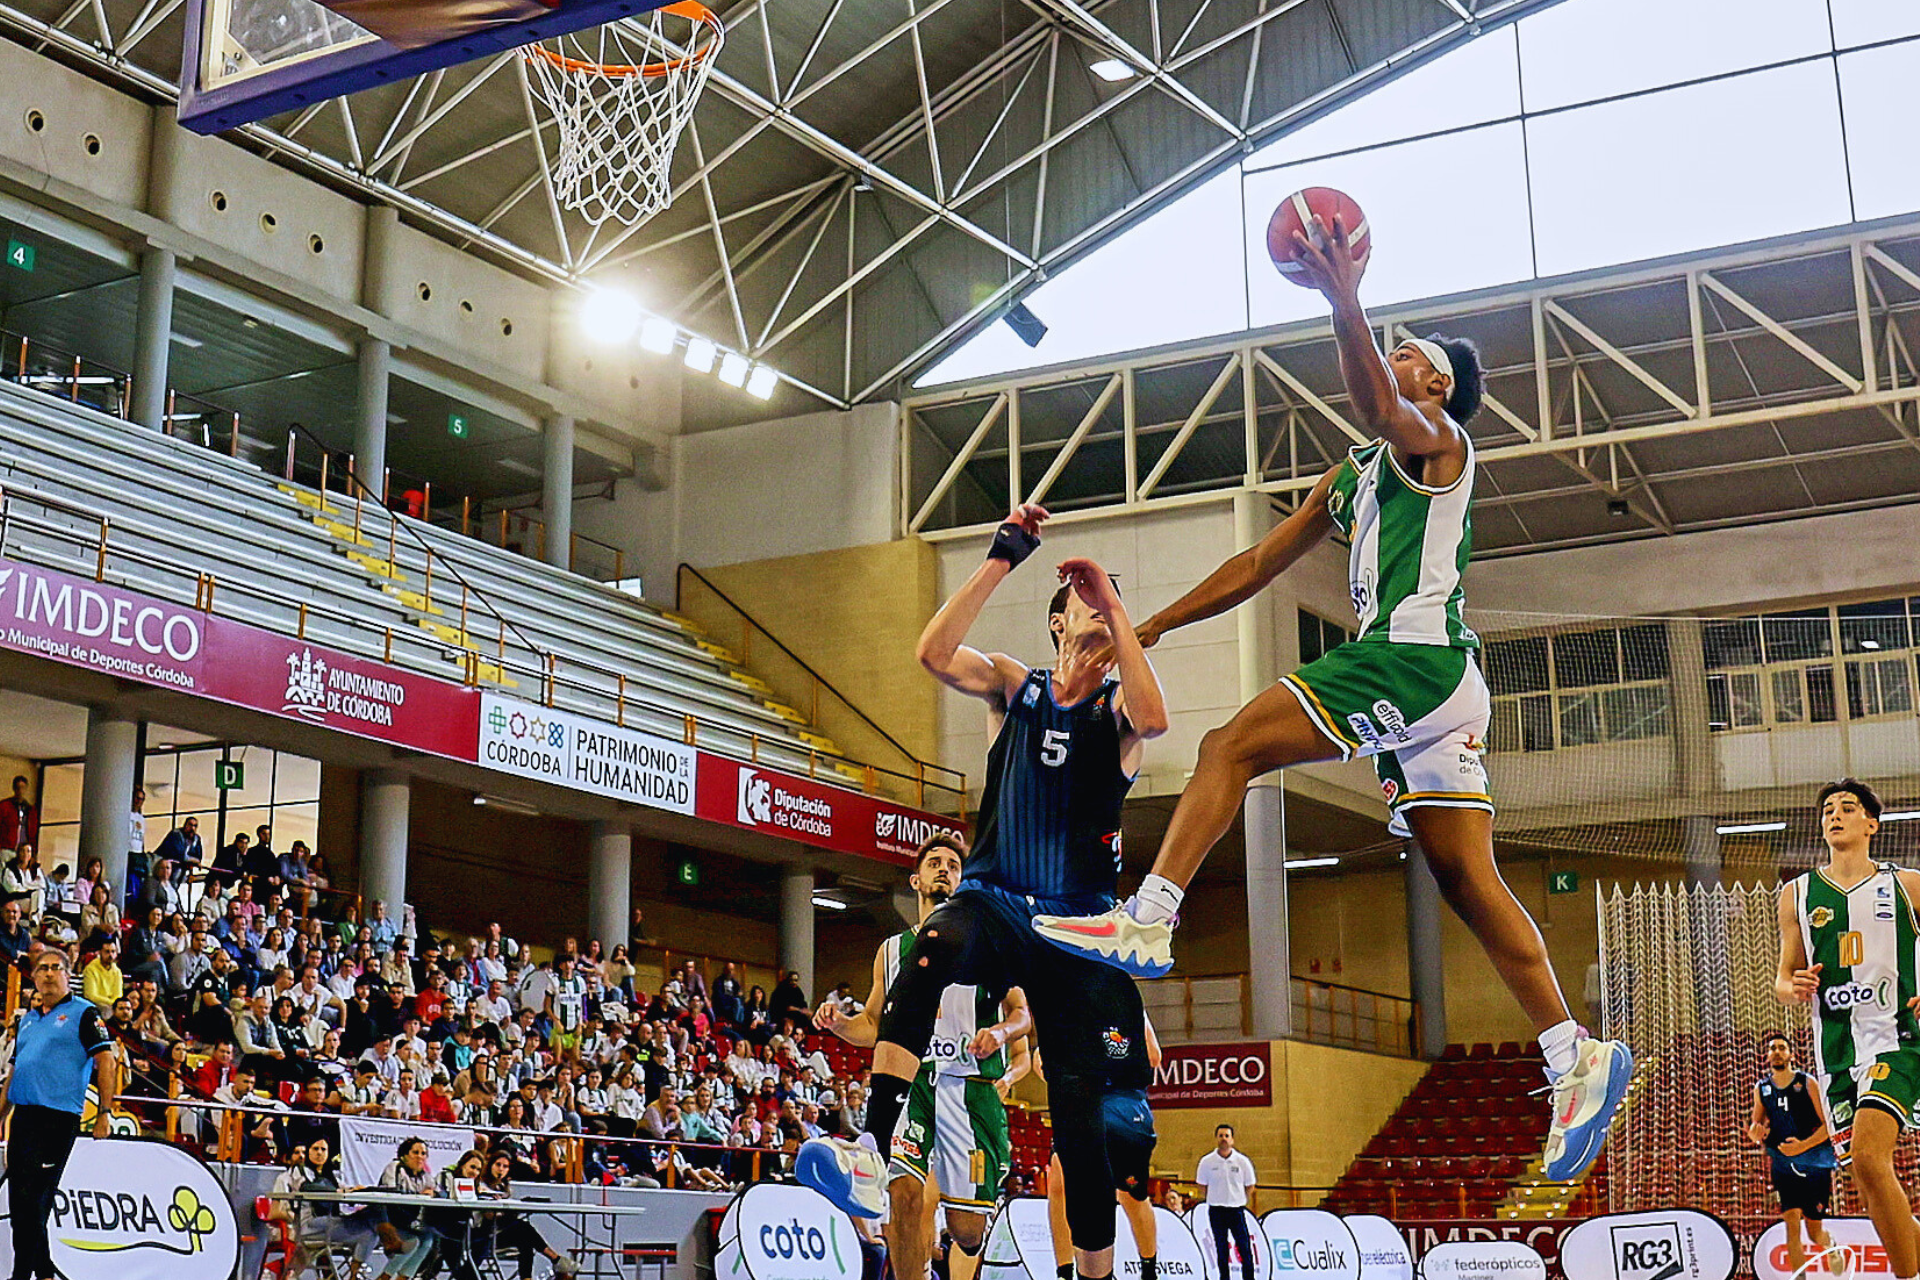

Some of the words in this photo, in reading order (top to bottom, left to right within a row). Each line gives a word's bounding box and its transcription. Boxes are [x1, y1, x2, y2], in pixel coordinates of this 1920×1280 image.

[13, 247, 25, 264] 4
[453, 418, 463, 434] 5
[14, 572, 199, 661] IMDECO
[7, 628, 69, 657] Municipal
[70, 645, 88, 661] de
[89, 648, 144, 676] Deportes
[145, 661, 195, 688] Córdoba
[328, 667, 405, 705] AYUNTAMIENTO
[327, 690, 342, 713] DE
[342, 694, 393, 726] CÓRDOBA
[486, 740, 562, 777] CÓRDOBA
[576, 729, 678, 774] PATRIMONIO
[1040, 729, 1070, 767] 5
[224, 764, 237, 785] D
[575, 754, 689, 804] HUMANIDAD
[774, 788, 831, 818] Diputación
[774, 809, 789, 827] de
[789, 812, 832, 836] Córdoba
[1556, 875, 1569, 890] K
[1828, 985, 1873, 1006] coto
[1152, 1056, 1265, 1086] MDECO
[1777, 1096, 1789, 1111] 4
[760, 1218, 826, 1260] coto
[1124, 1260, 1194, 1275] ATSVEGA
[1292, 1239, 1347, 1270] Cualix
[1454, 1256, 1541, 1273] federópticos
[1621, 1239, 1673, 1271] RG3
